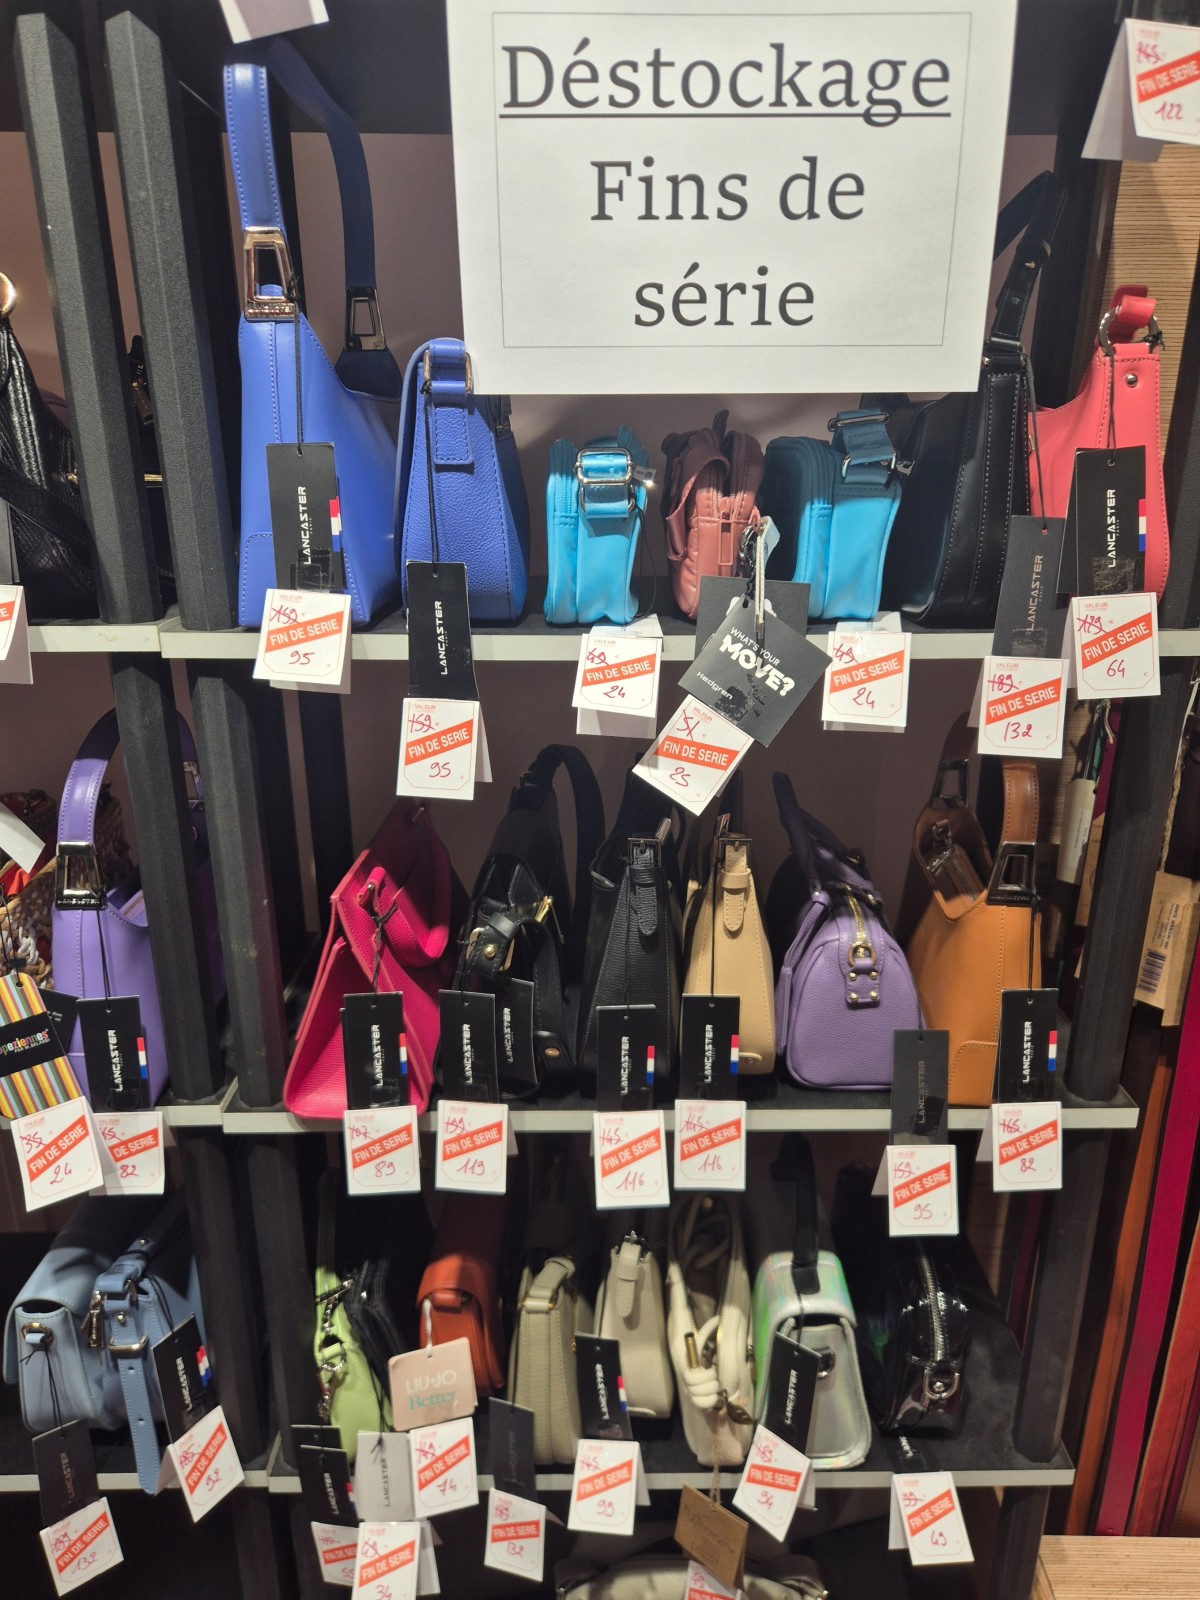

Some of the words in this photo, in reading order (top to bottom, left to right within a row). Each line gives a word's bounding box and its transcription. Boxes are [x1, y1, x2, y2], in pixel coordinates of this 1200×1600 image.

[501, 37, 951, 127] Déstockage
[1138, 78, 1158, 95] FIN
[1155, 71, 1172, 89] DE
[1168, 60, 1200, 83] SERIE
[1154, 101, 1183, 121] 122
[590, 156, 748, 221] Fins
[779, 156, 865, 220] de
[634, 261, 815, 327] série
[298, 486, 312, 565] LANCASTER
[1107, 489, 1117, 568] LANCASTER
[1027, 555, 1044, 632] LANCASTER
[270, 631, 289, 646] FIN
[290, 625, 306, 640] DE
[306, 618, 340, 637] SERIE
[434, 600, 448, 676] LANCASTER
[1083, 643, 1102, 661] FIN
[1101, 633, 1118, 652] DE
[1117, 621, 1149, 645] SERIE
[289, 650, 315, 665] 95
[586, 671, 603, 682] FIN
[604, 669, 620, 678] DE
[621, 661, 652, 675] SERIE
[718, 634, 796, 697] MOVE?
[758, 648, 780, 667] YOUR
[833, 674, 851, 686] FIN
[852, 668, 868, 682] DE
[869, 658, 901, 676] SERIE
[1107, 659, 1125, 678] 64
[603, 685, 626, 698] 24
[696, 671, 733, 700] Hedgren
[853, 687, 875, 709] 24
[989, 701, 1007, 717] FIN
[1008, 695, 1024, 711] DE
[1024, 686, 1057, 706] SERIE
[408, 743, 425, 759] FIN
[426, 736, 441, 752] DE
[440, 728, 470, 748] SERIE
[1004, 722, 1033, 742] 132
[429, 761, 452, 778] 95
[663, 740, 680, 755] FIN
[681, 745, 697, 759] DE
[697, 748, 729, 766] SERIE
[502, 1007, 514, 1063] LANCASTER
[107, 1029, 123, 1093] LANCASTER
[371, 1024, 384, 1087] LANCASTER
[462, 1023, 473, 1084] LANCASTER
[620, 1036, 630, 1095] LANCASTER
[703, 1024, 714, 1084] LANCASTER
[1022, 1021, 1033, 1084] LANCASTER
[918, 1060, 926, 1124] LANCASTER
[29, 1155, 47, 1174] FIN
[45, 1143, 60, 1161] DE
[57, 1123, 88, 1151] SERIE
[113, 1142, 129, 1157] DE
[127, 1133, 158, 1152] SERIE
[353, 1150, 370, 1163] FIN
[370, 1142, 384, 1155] DE
[383, 1130, 411, 1150] SERIE
[445, 1141, 460, 1156] FIN
[460, 1135, 473, 1149] DE
[473, 1127, 500, 1146] SERIE
[603, 1156, 620, 1171] FIN
[620, 1148, 633, 1162] DE
[632, 1136, 659, 1155] SERIE
[683, 1140, 699, 1155] FIN
[699, 1134, 712, 1148] DE
[711, 1124, 739, 1143] SERIE
[1001, 1144, 1016, 1159] FIN
[1016, 1137, 1030, 1152] DE
[1029, 1126, 1056, 1147] SERIE
[119, 1164, 139, 1178] 82
[374, 1160, 396, 1178] 89
[895, 1187, 910, 1202] FIN
[910, 1179, 924, 1194] DE
[923, 1168, 949, 1188] SERIE
[913, 1203, 933, 1220] 95
[176, 1356, 192, 1411] LANCASTER
[785, 1369, 798, 1425] LANCASTER
[188, 1473, 202, 1489] FIN
[199, 1460, 208, 1475] DE
[206, 1432, 226, 1461] SERIE
[419, 1470, 434, 1484] FIN
[432, 1460, 446, 1474] DE
[444, 1444, 468, 1464] SERIE
[324, 1472, 339, 1515] LANCASTER
[380, 1458, 391, 1507] LANCASTER
[579, 1482, 593, 1495] FIN
[594, 1475, 607, 1489] DE
[607, 1466, 631, 1485] SERIE
[750, 1468, 762, 1481] FIN
[762, 1471, 774, 1483] DE
[775, 1473, 797, 1488] SERIE
[910, 1516, 922, 1529] FIN
[921, 1507, 934, 1522] DE
[931, 1497, 953, 1517] SERIE
[58, 1551, 72, 1567] FIN
[72, 1539, 84, 1555] DE
[82, 1518, 108, 1543] SERIE
[361, 1565, 376, 1579] FIN
[376, 1559, 388, 1571] DE
[388, 1547, 412, 1565] SERIE
